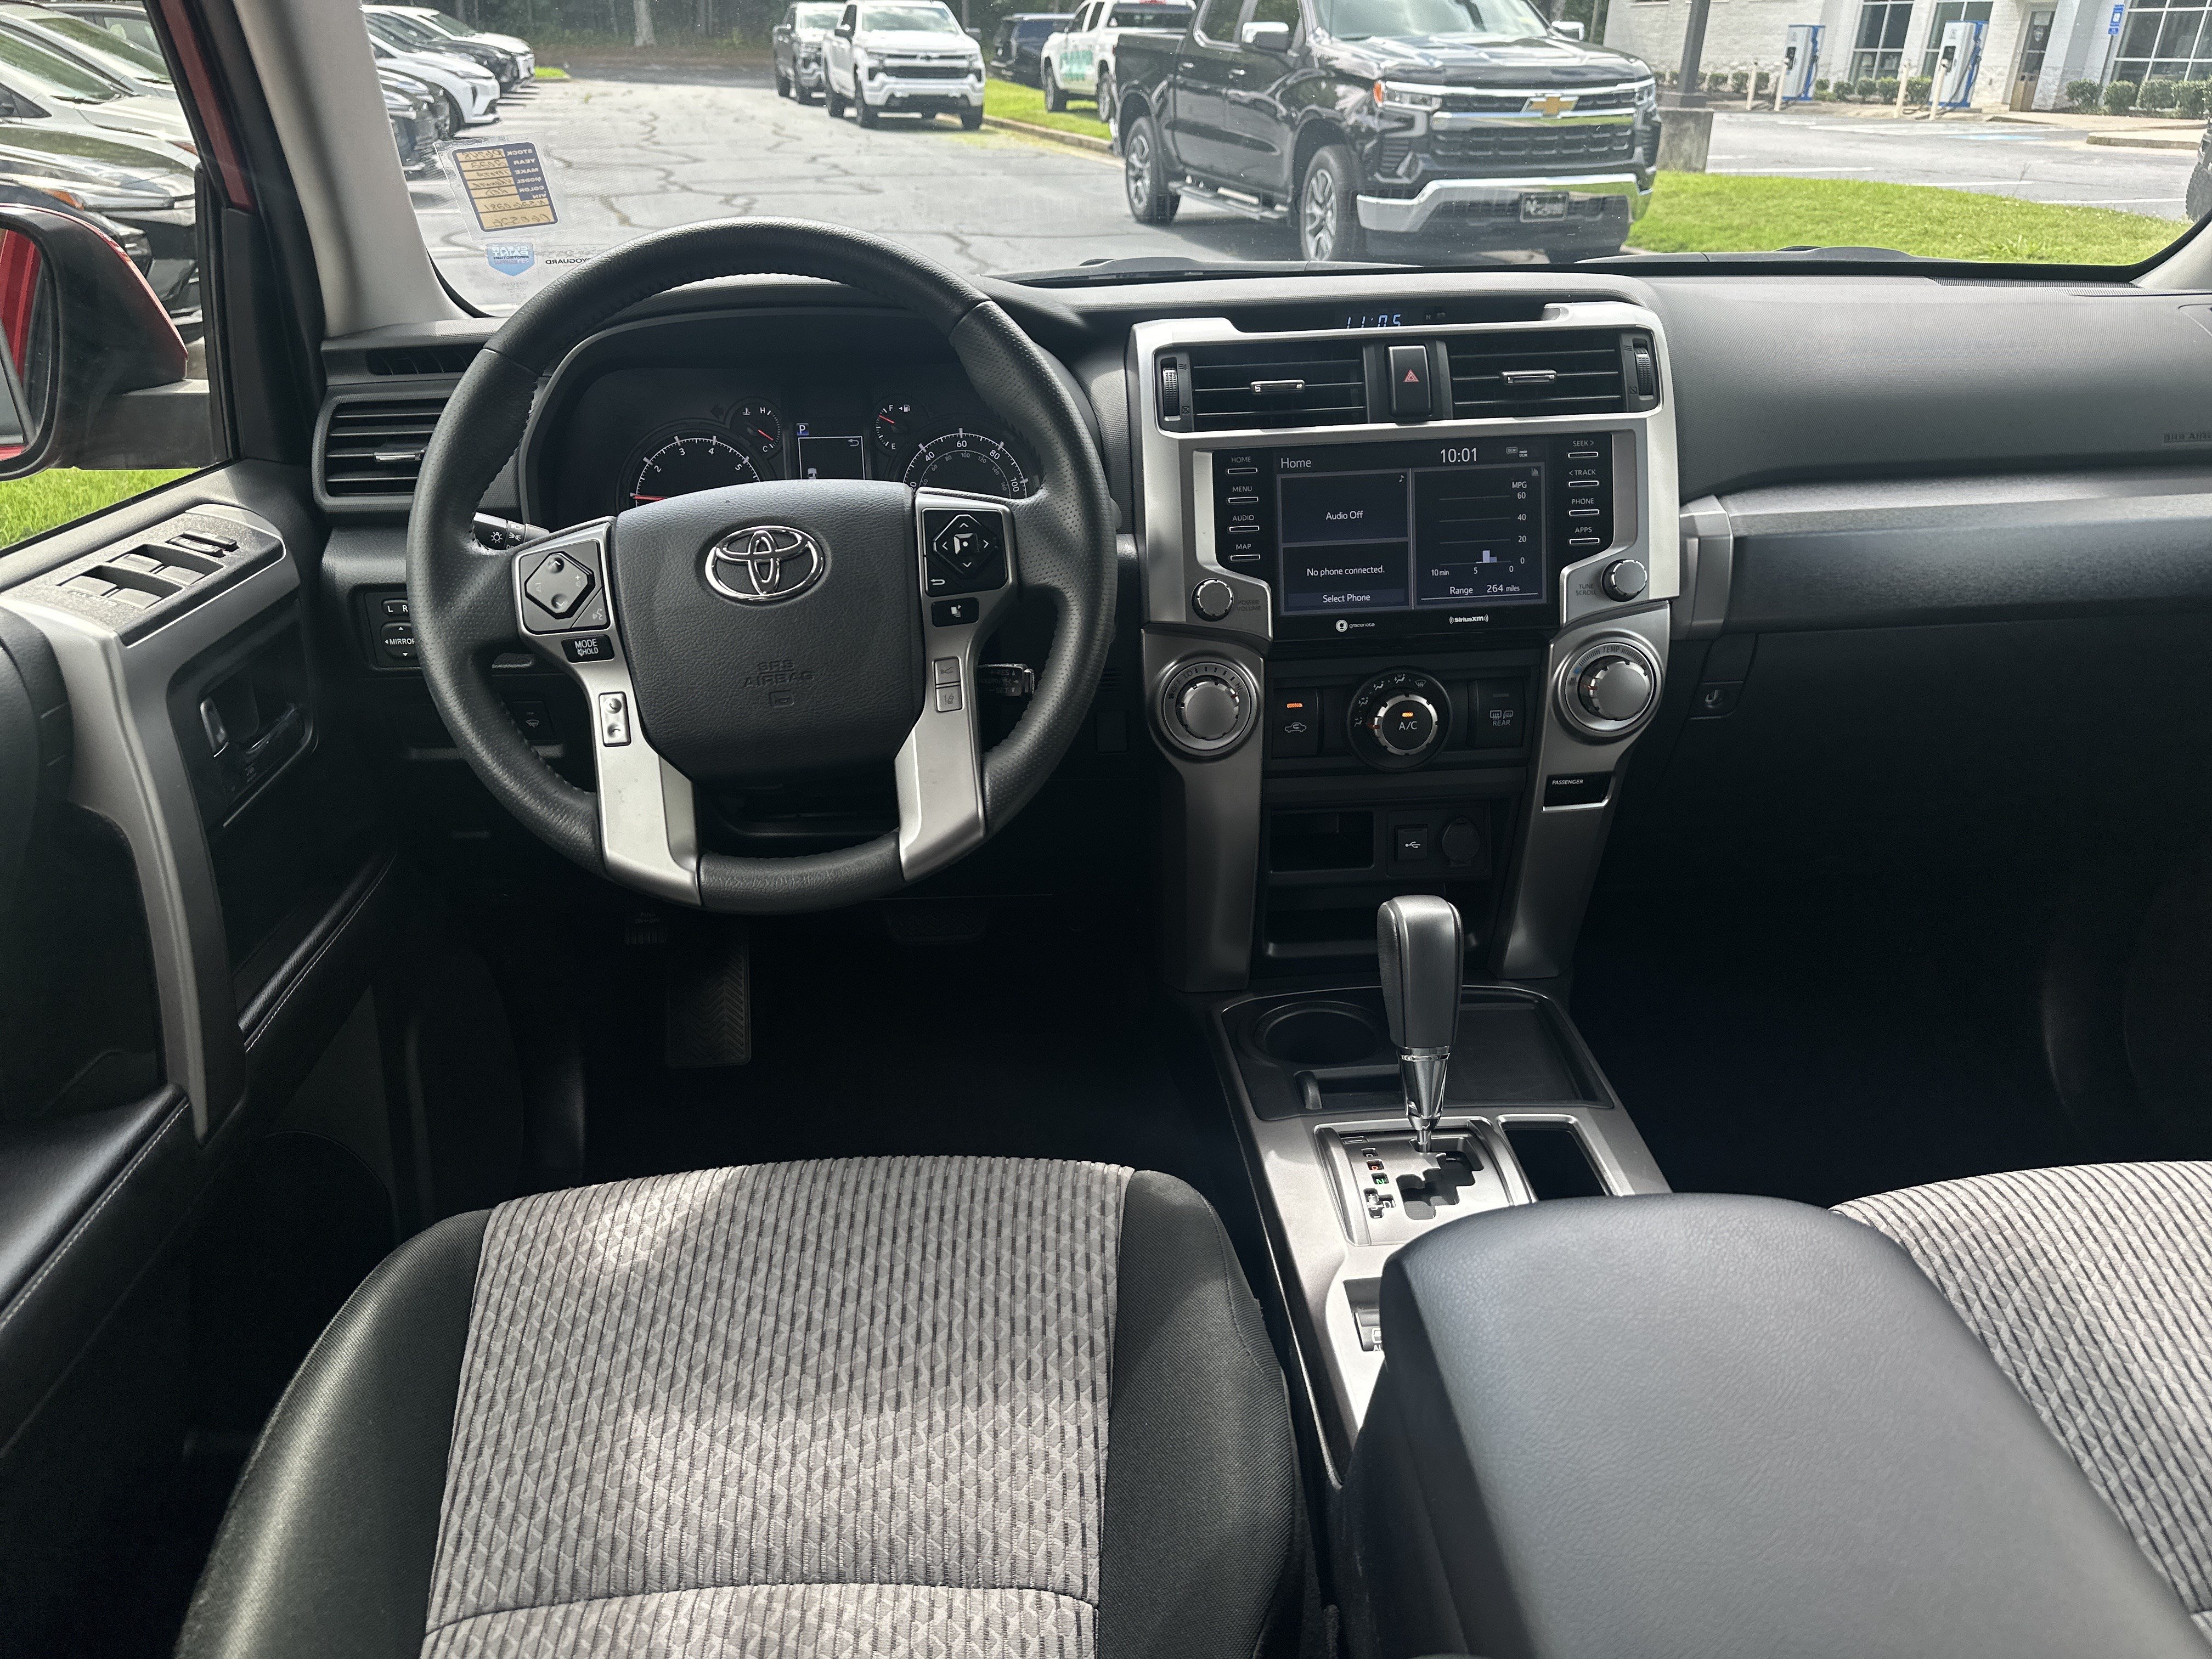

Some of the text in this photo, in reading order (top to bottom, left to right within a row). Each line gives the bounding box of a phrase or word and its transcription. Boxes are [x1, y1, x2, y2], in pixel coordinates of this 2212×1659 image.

[799, 425, 805, 435] P
[925, 452, 935, 461] 40
[989, 449, 1000, 460] 80
[1441, 448, 1476, 462] 10:01
[735, 463, 743, 471] 5
[1281, 458, 1311, 468] Home
[991, 466, 1000, 475] 140
[1010, 477, 1019, 492] 100
[1326, 511, 1363, 520] Audio Off
[1321, 568, 1342, 577] phone
[1345, 565, 1384, 574] connected.
[1450, 586, 1473, 595] Range
[1487, 584, 1503, 592] 264
[575, 639, 597, 648] MODE
[583, 647, 599, 656] HOLD
[1602, 645, 1621, 654] TEMP
[1171, 679, 1182, 692] OFF
[1399, 721, 1417, 730] A/C
